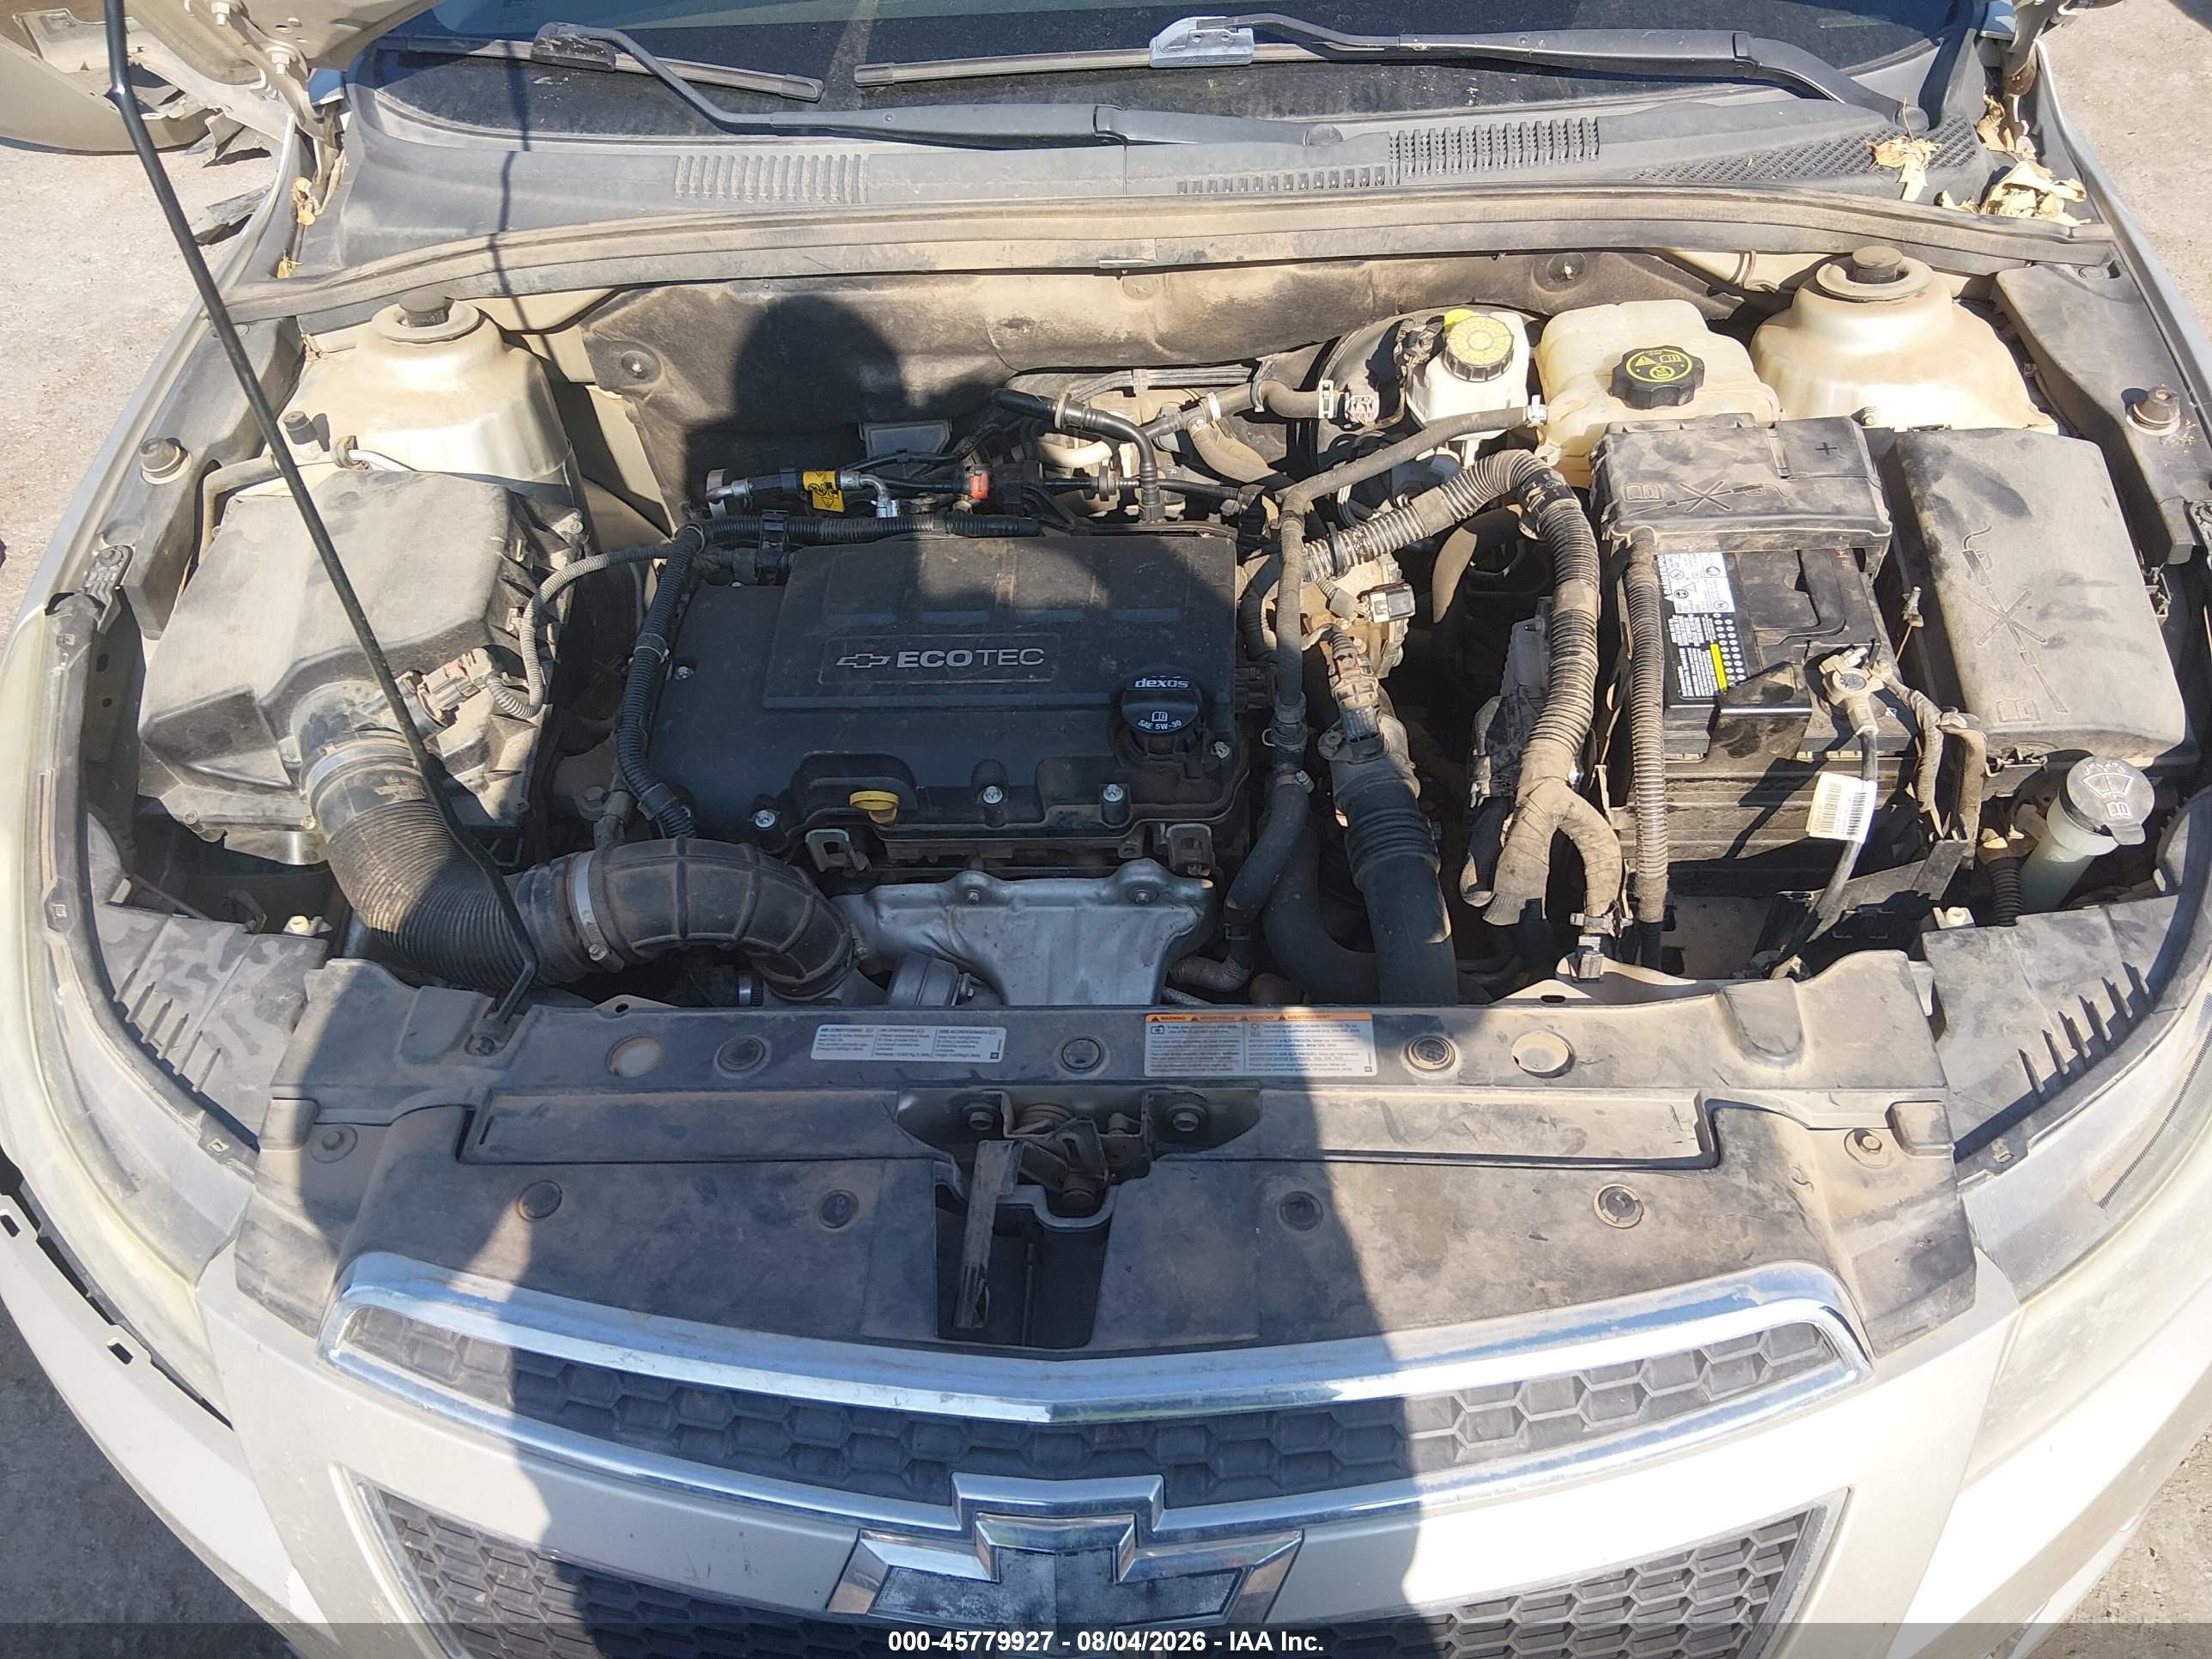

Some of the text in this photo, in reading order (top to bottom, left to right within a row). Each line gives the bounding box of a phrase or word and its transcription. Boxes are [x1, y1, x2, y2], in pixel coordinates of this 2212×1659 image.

[896, 647, 1045, 668] ECOTEC
[1134, 678, 1190, 688] dexos
[1138, 720, 1182, 730] SAE 5W-30
